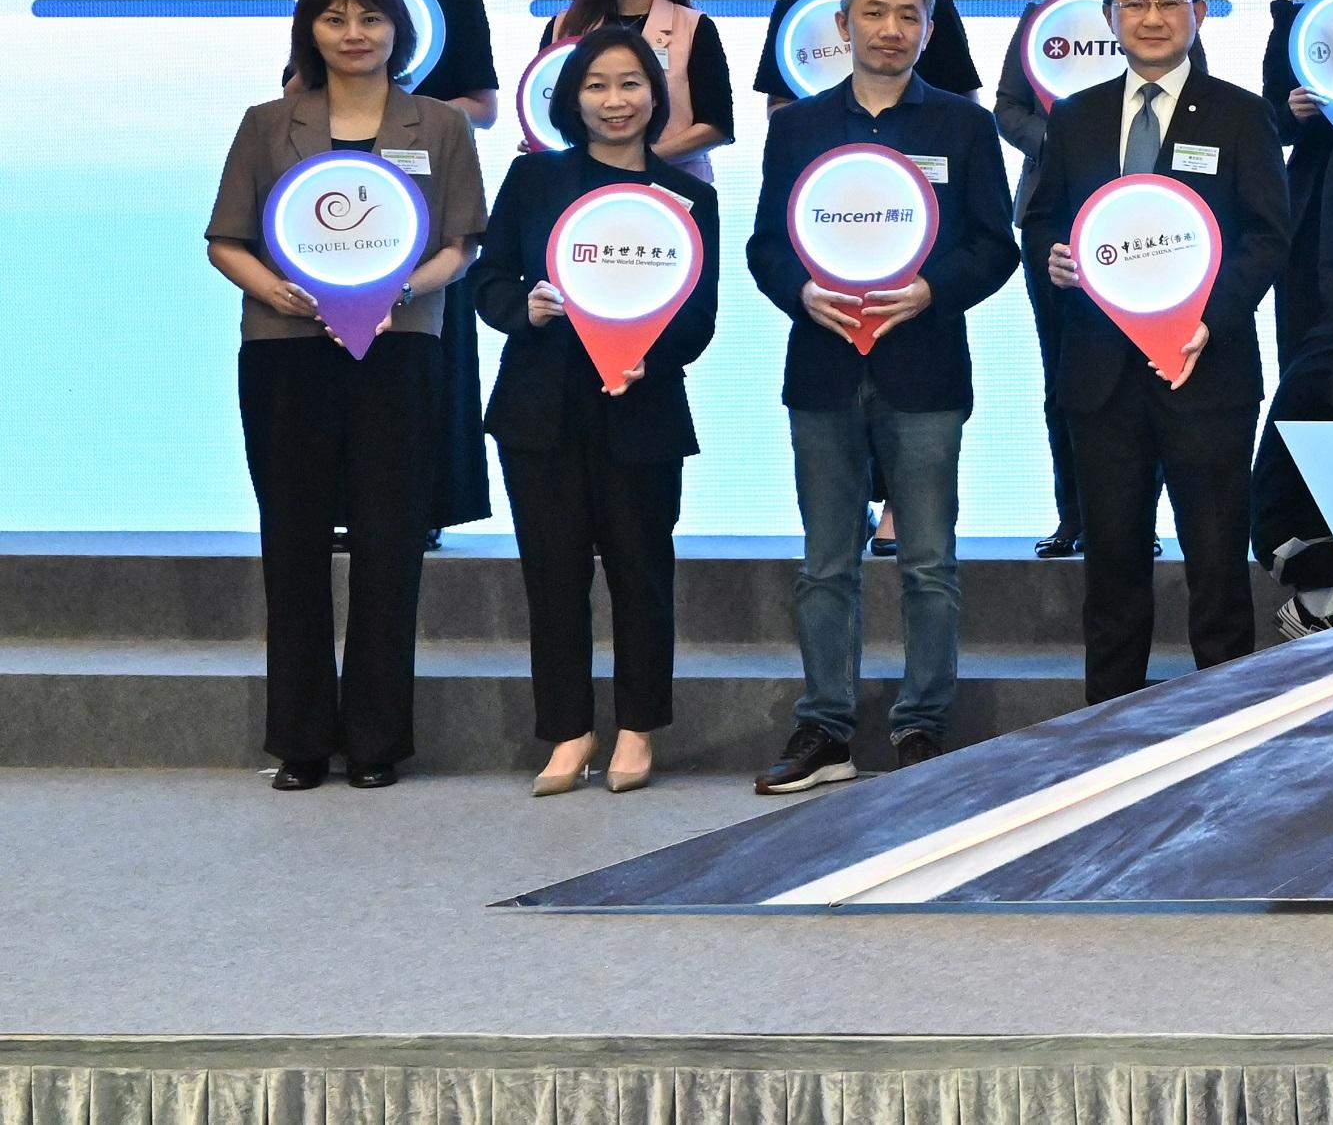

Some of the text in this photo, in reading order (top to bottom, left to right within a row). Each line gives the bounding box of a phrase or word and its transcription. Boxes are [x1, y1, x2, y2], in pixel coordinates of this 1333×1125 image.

[812, 45, 843, 59] BEA
[1073, 40, 1126, 56] MTR
[812, 208, 914, 223] Tencent 腾讯
[298, 238, 400, 253] ESQUEL GROUP
[1124, 254, 1141, 262] BANK
[1151, 248, 1172, 257] CHINA
[635, 259, 677, 267] Development
